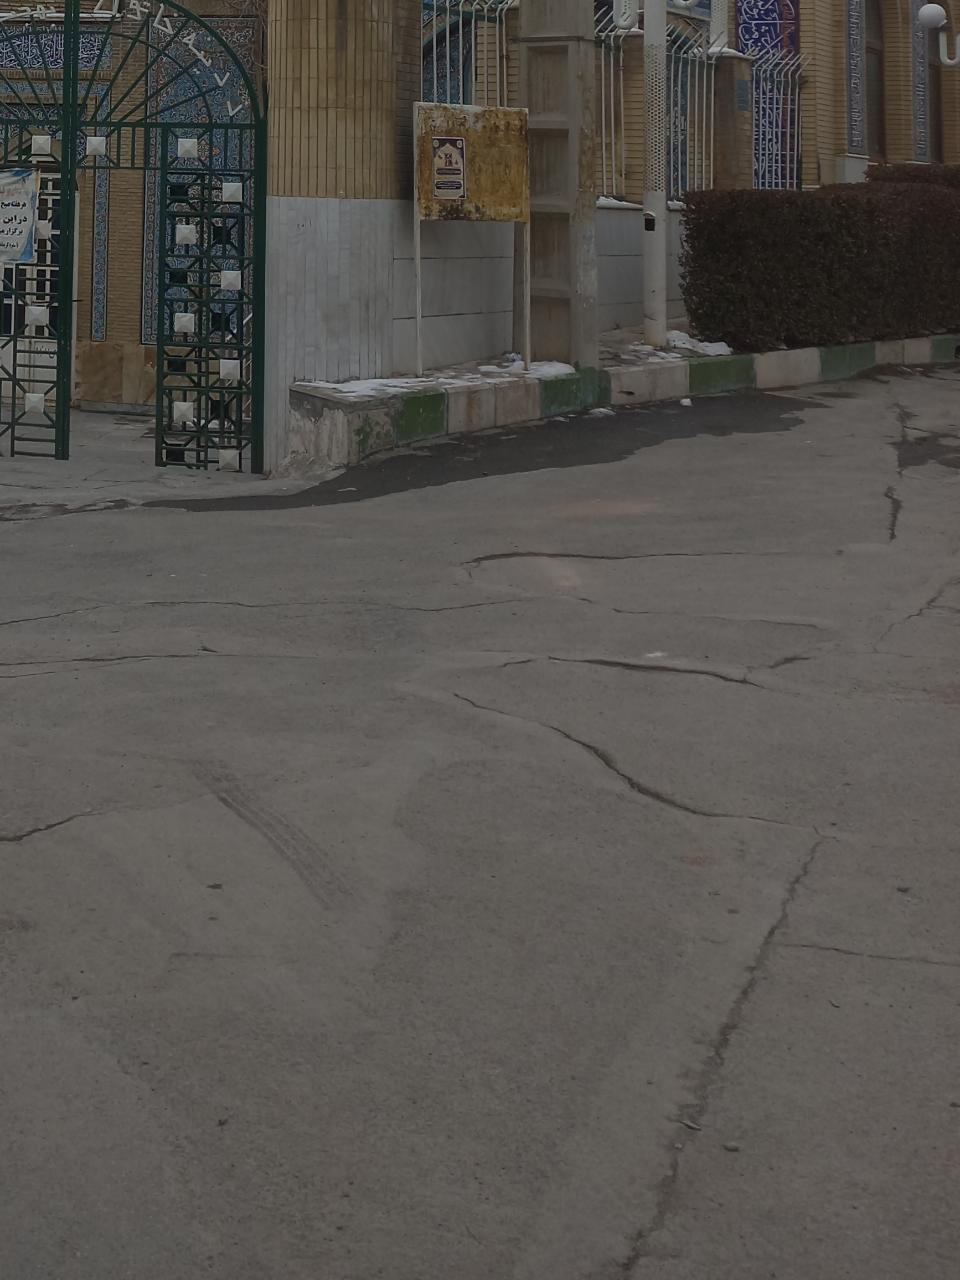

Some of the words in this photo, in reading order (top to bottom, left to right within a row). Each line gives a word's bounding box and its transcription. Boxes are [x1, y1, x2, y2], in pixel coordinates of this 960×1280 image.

[3, 214, 17, 224] این
[17, 216, 28, 225] در
[6, 227, 24, 236] برگزار
